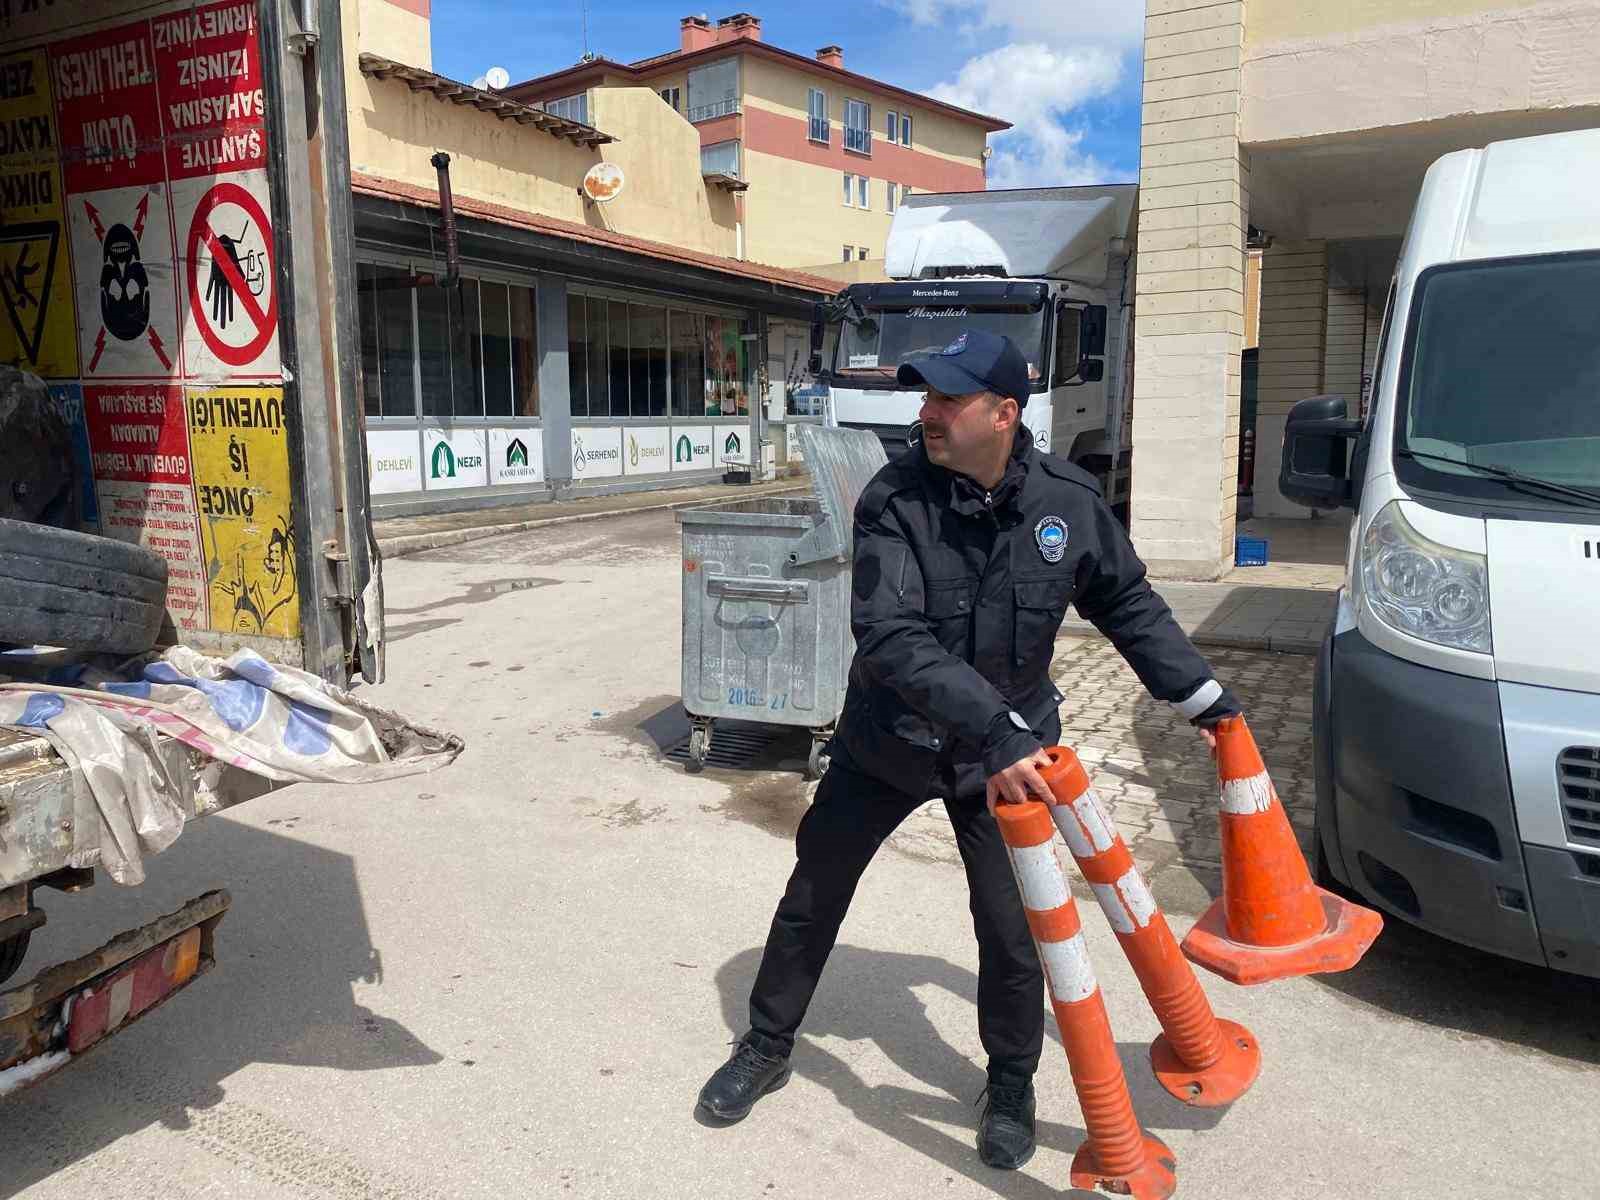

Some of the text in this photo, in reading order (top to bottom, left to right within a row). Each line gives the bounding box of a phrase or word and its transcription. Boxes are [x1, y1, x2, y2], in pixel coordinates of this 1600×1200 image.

[154, 3, 257, 53] İRMEYİNİZ
[55, 37, 153, 111] TEHLİKESİ
[177, 48, 249, 89] İZİNSİZ
[169, 88, 264, 128] SAHASINA
[82, 113, 137, 172] ÖLÜM
[182, 128, 261, 171] ŞANTİYE
[912, 289, 960, 297] Mercedes-Benz
[111, 424, 160, 442] ALMADAN
[189, 397, 286, 435] ÜVENLİĞİ
[133, 453, 187, 478] GÜVENLİK
[229, 434, 249, 480] İŞ
[587, 446, 619, 460] SERHENDİ
[200, 485, 254, 523] ÖNCE
